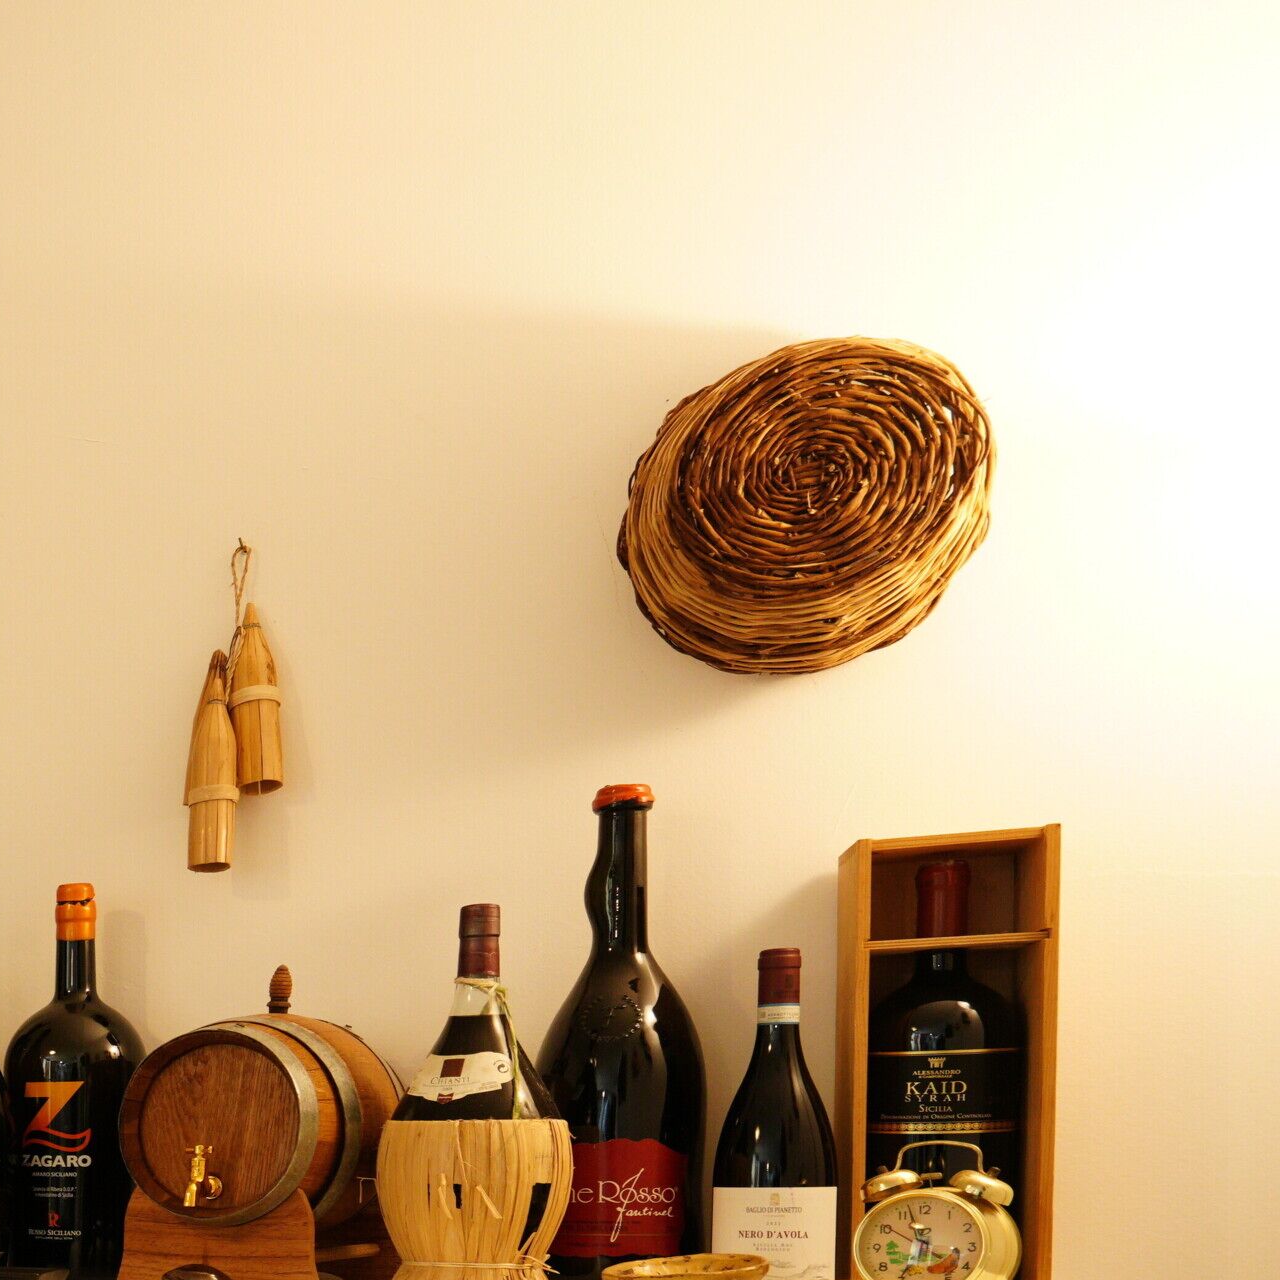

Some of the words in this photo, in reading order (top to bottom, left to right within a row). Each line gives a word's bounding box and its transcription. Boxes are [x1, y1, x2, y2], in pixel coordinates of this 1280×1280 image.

[906, 1080, 968, 1095] KAID
[904, 1094, 966, 1102] SYRAH
[919, 1204, 932, 1215] 12
[898, 1210, 907, 1220] 11
[947, 1210, 952, 1220] 1
[880, 1224, 892, 1235] 10
[962, 1223, 972, 1233] 2
[739, 1230, 764, 1239] NERO
[767, 1230, 809, 1239] D'AVOLA
[872, 1243, 881, 1253] 9
[967, 1242, 977, 1252] 3
[878, 1261, 888, 1272] 8
[961, 1261, 971, 1271] 4
